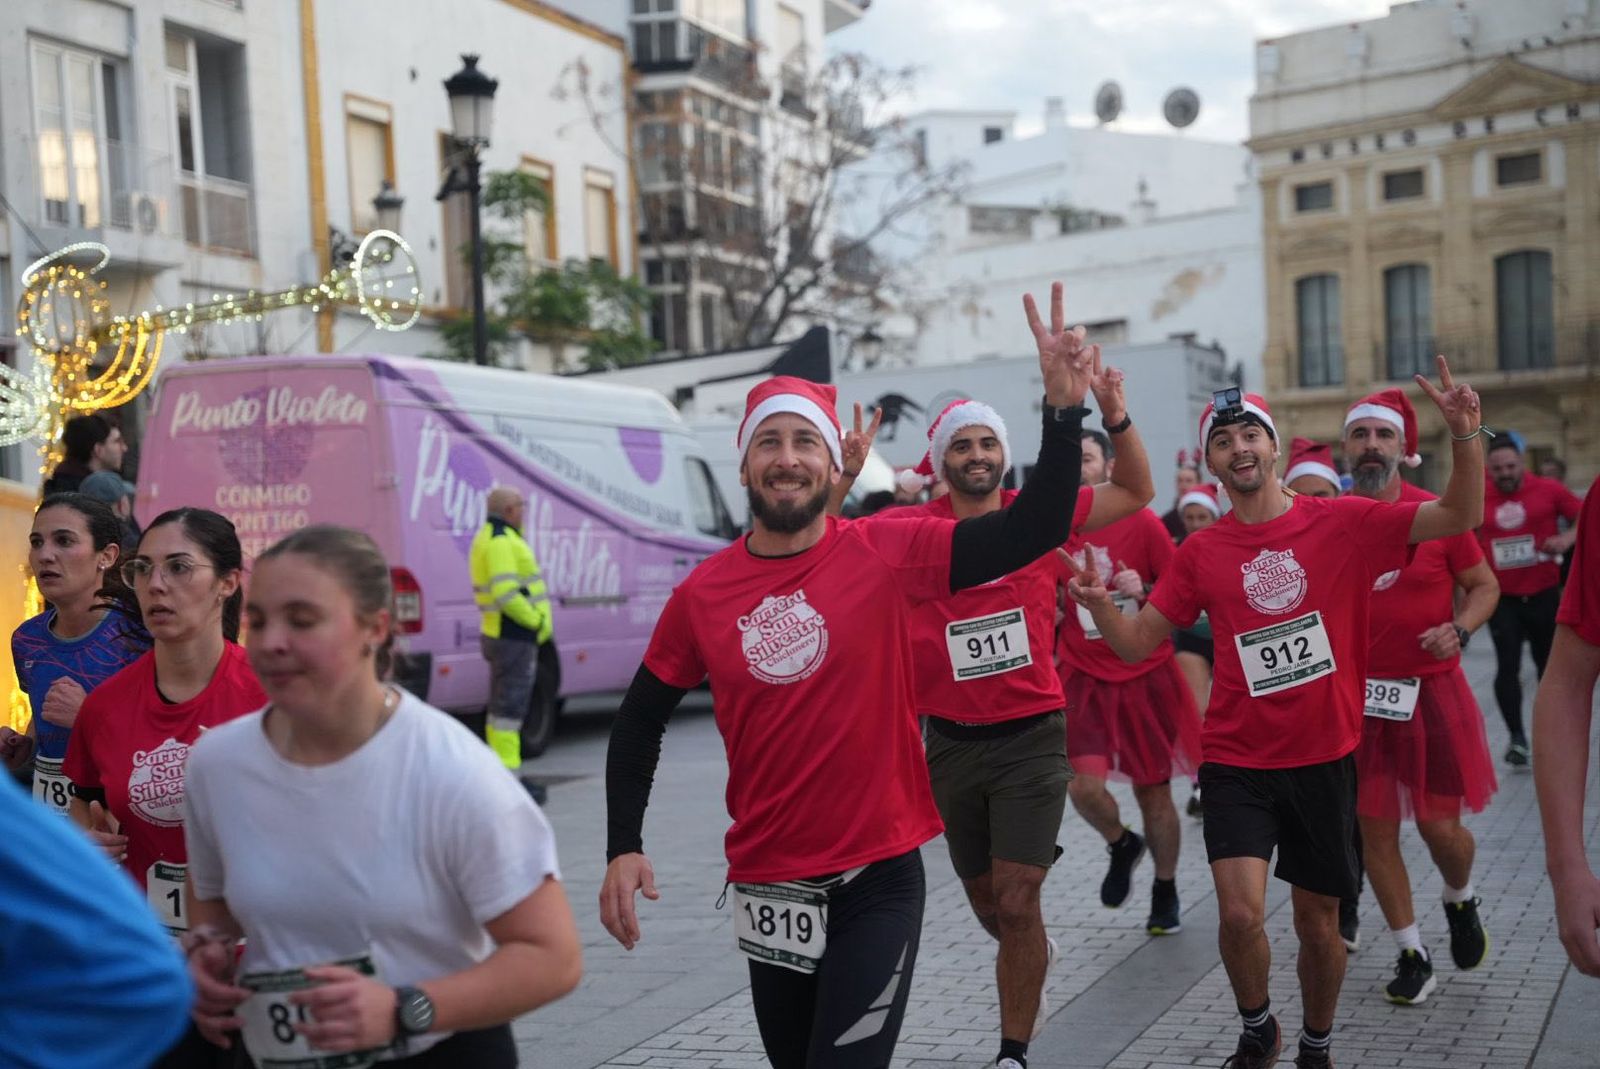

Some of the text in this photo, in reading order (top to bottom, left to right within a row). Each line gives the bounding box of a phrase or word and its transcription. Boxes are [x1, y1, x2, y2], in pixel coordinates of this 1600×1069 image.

[170, 384, 368, 438] Punto Violeta
[215, 483, 312, 508] CONMIGO
[235, 510, 310, 532] ONTIGO
[1241, 548, 1295, 575] Carrera
[1258, 564, 1287, 582] San
[1246, 568, 1306, 599] Silvestre
[737, 588, 807, 632] Carrera
[745, 613, 825, 665] Silvestre
[758, 612, 799, 640] San
[967, 630, 1010, 659] 911
[1260, 636, 1313, 670] 912
[1270, 659, 1311, 676] PEDRO JAIME
[132, 750, 188, 768] Carre
[744, 901, 813, 944] 1819
[268, 1002, 306, 1044] 8
